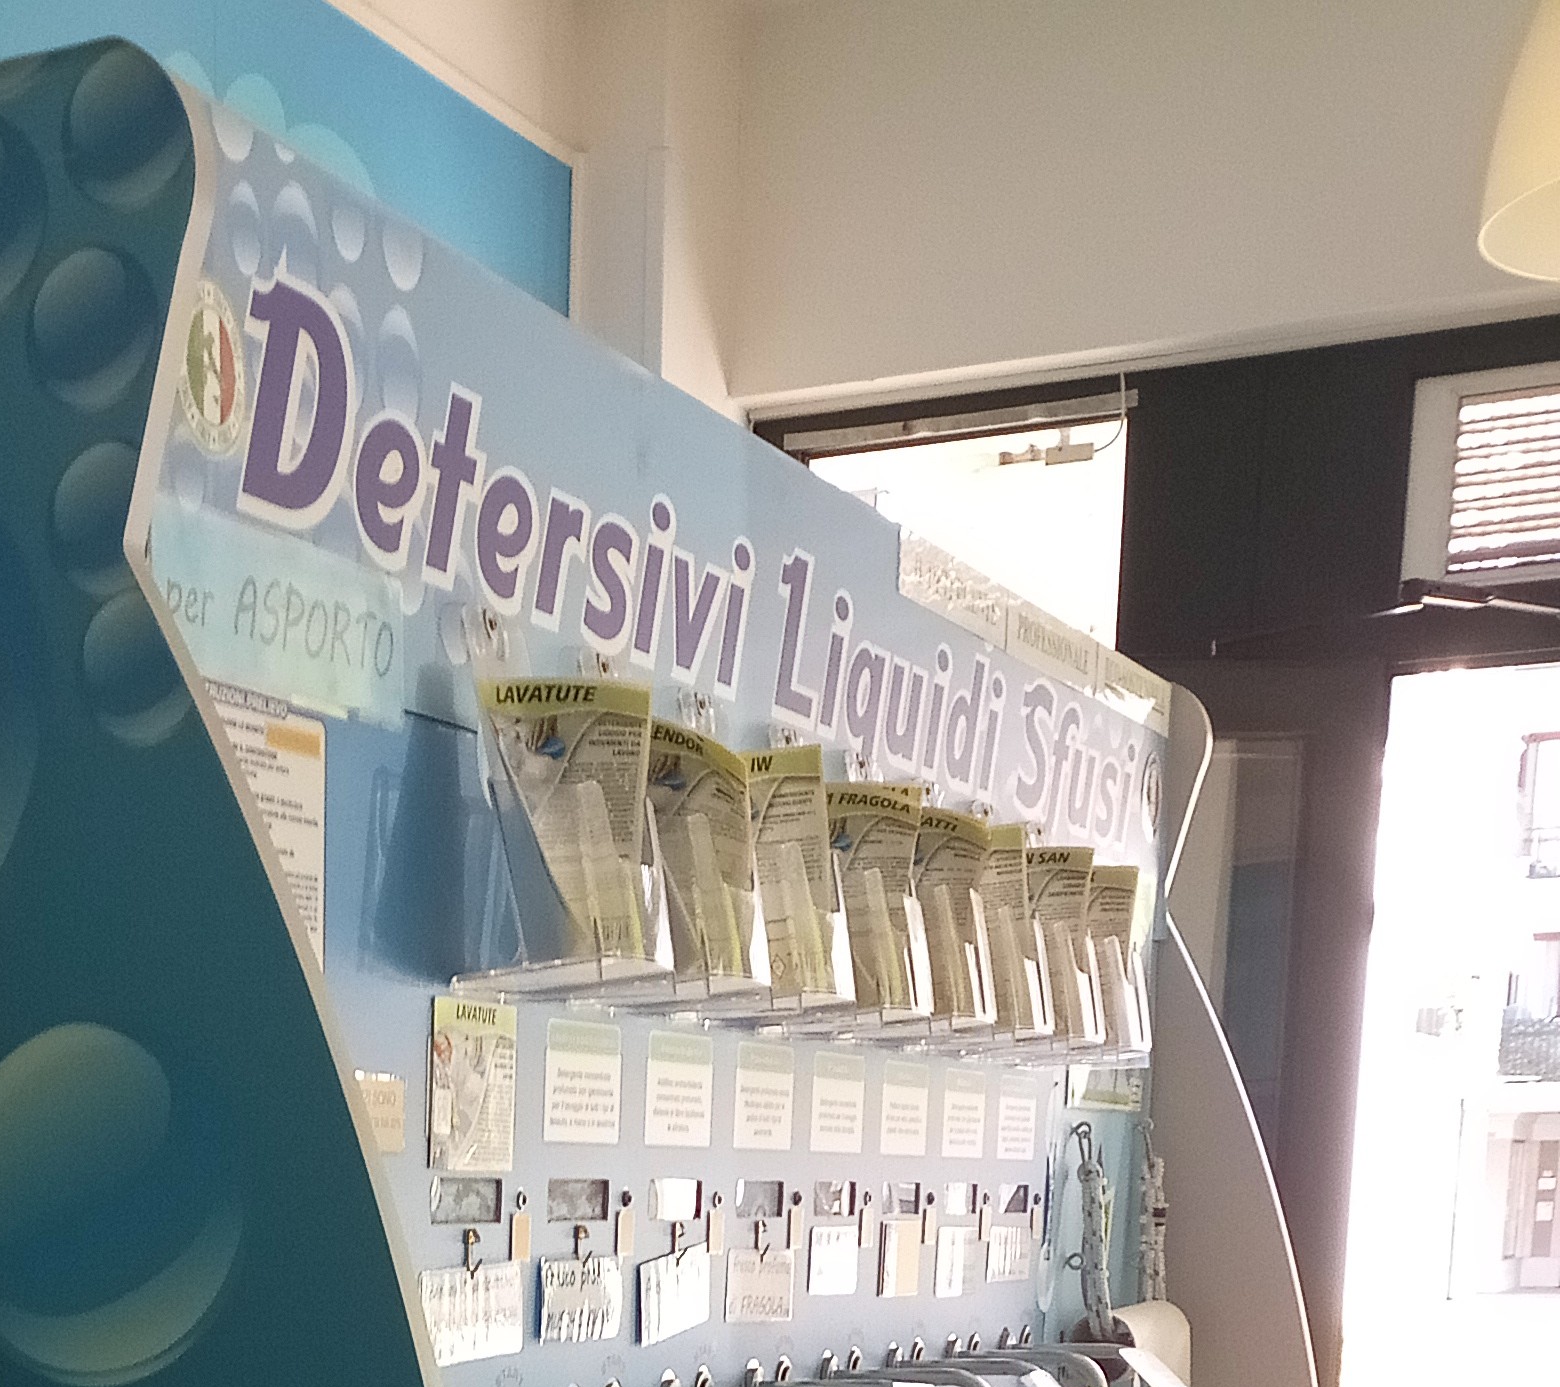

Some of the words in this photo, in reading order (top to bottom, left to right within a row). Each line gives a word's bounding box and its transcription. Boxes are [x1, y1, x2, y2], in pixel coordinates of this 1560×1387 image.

[239, 272, 753, 697] Detersivi
[773, 549, 1006, 798] Liquidi
[1013, 678, 1138, 848] Sfusi
[166, 577, 214, 627] per
[234, 574, 394, 678] ASPORTO
[496, 683, 598, 704] LAVATUTE
[838, 791, 912, 815] FRAGOLA
[920, 814, 959, 833] ATTI
[1038, 851, 1071, 865] SAN
[455, 1003, 498, 1026] LAVATUTE
